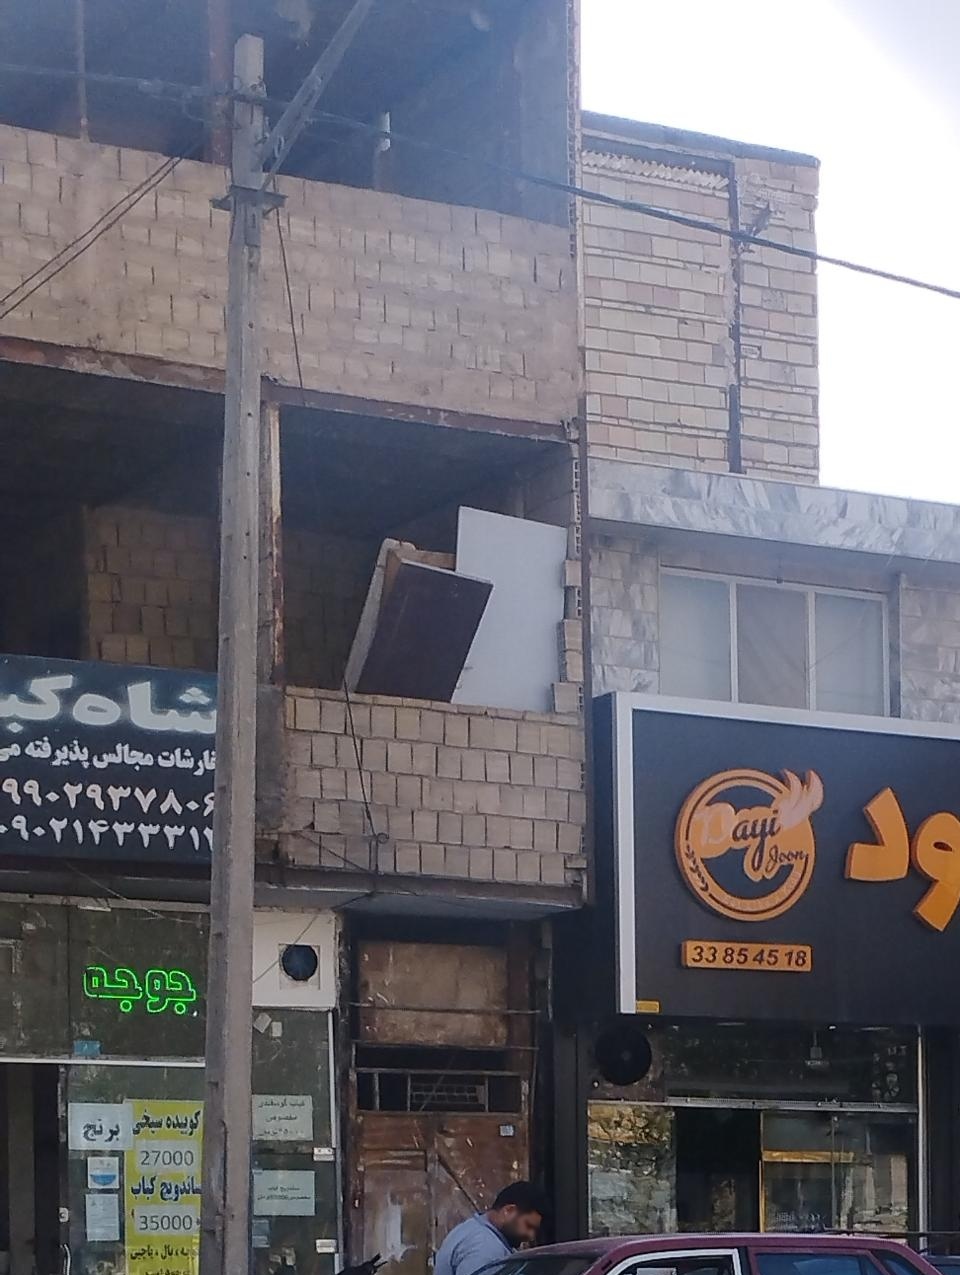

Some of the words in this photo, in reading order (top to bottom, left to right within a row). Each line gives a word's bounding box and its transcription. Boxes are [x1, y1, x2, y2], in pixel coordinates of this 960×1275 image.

[92, 743, 154, 771] مجالس
[157, 748, 216, 776] ارشات
[764, 844, 807, 874] Joon
[83, 966, 197, 1014] جوجه
[82, 1118, 120, 1143] برنج
[165, 1110, 201, 1136] کوبیده
[140, 1150, 194, 1166] 27000
[130, 1175, 157, 1200] کباب
[138, 1215, 193, 1231] 35000
